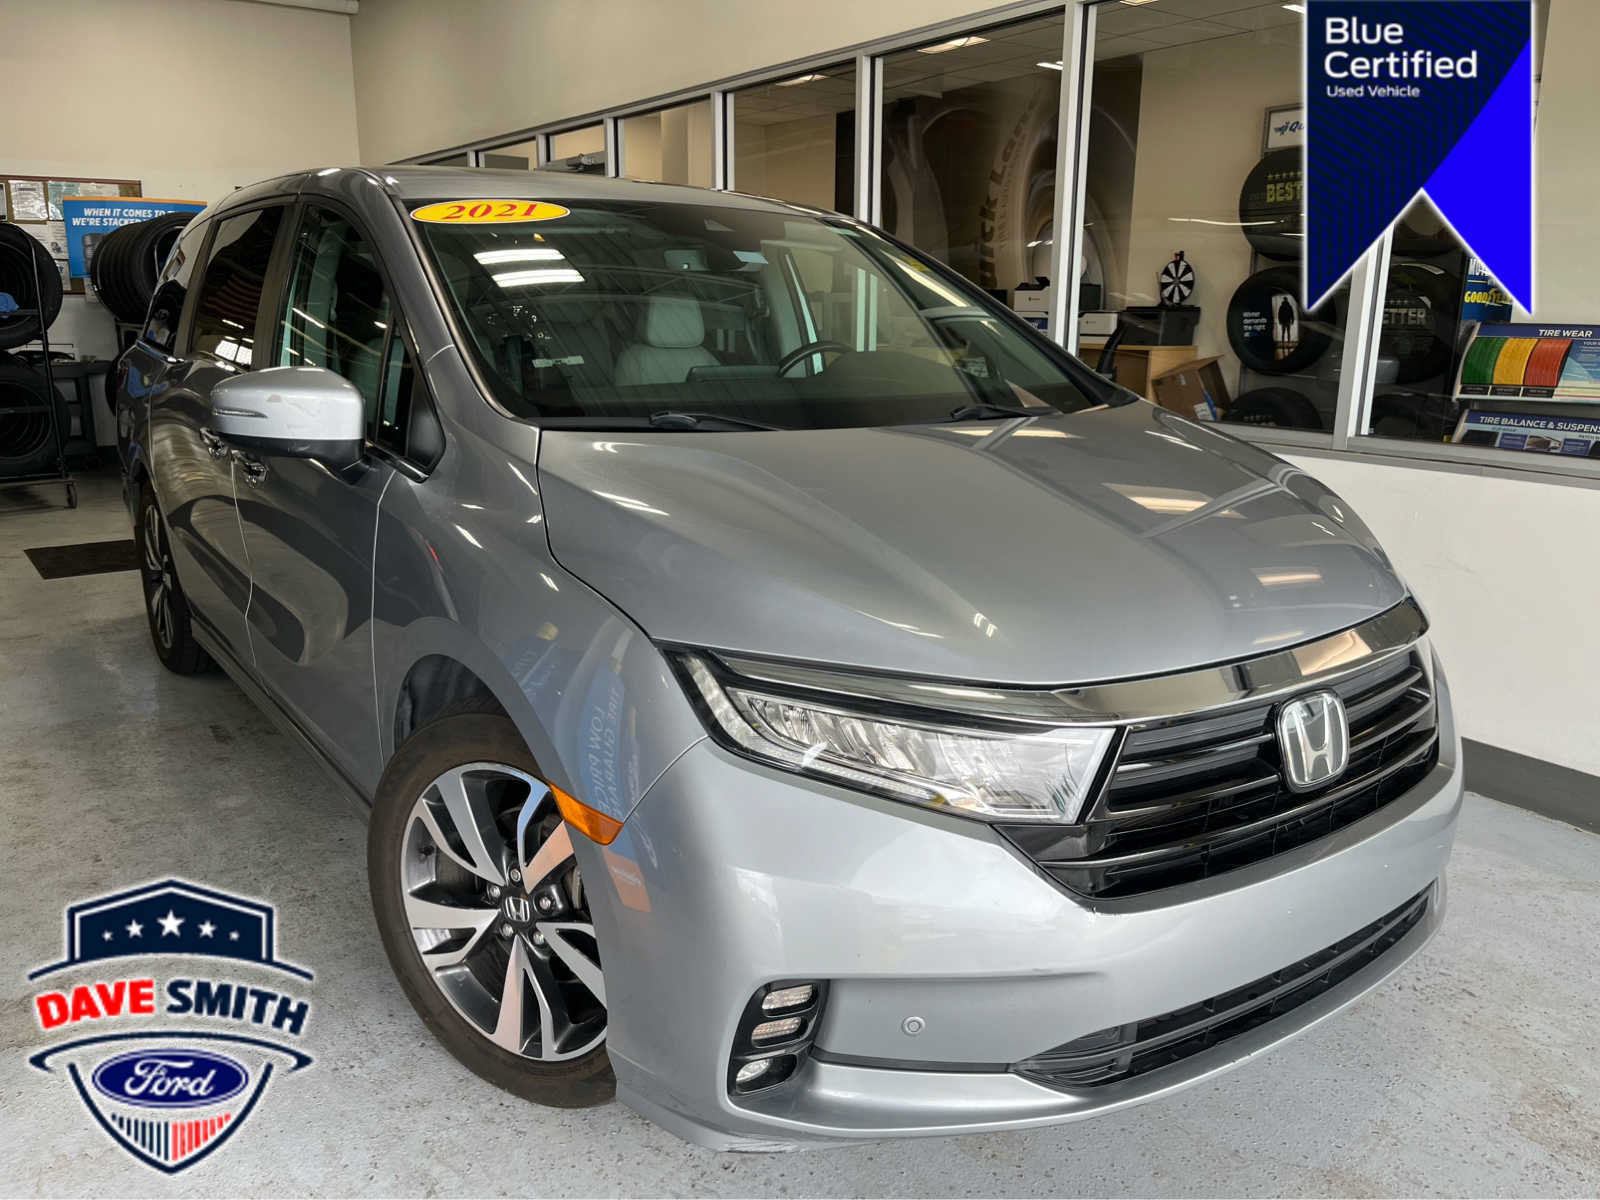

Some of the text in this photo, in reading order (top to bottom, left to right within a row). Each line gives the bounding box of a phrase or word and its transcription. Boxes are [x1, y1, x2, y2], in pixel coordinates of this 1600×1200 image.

[83, 207, 111, 217] WHEN
[112, 208, 122, 217] IT
[122, 208, 153, 218] COMES
[442, 203, 538, 220] 2021
[72, 217, 101, 226] WE'RE
[1381, 308, 1426, 325] ETTER
[1538, 328, 1593, 338] TIRE WEAR
[1479, 416, 1500, 425] TIRE
[1501, 417, 1546, 428] BALANCE
[1547, 420, 1555, 429] &
